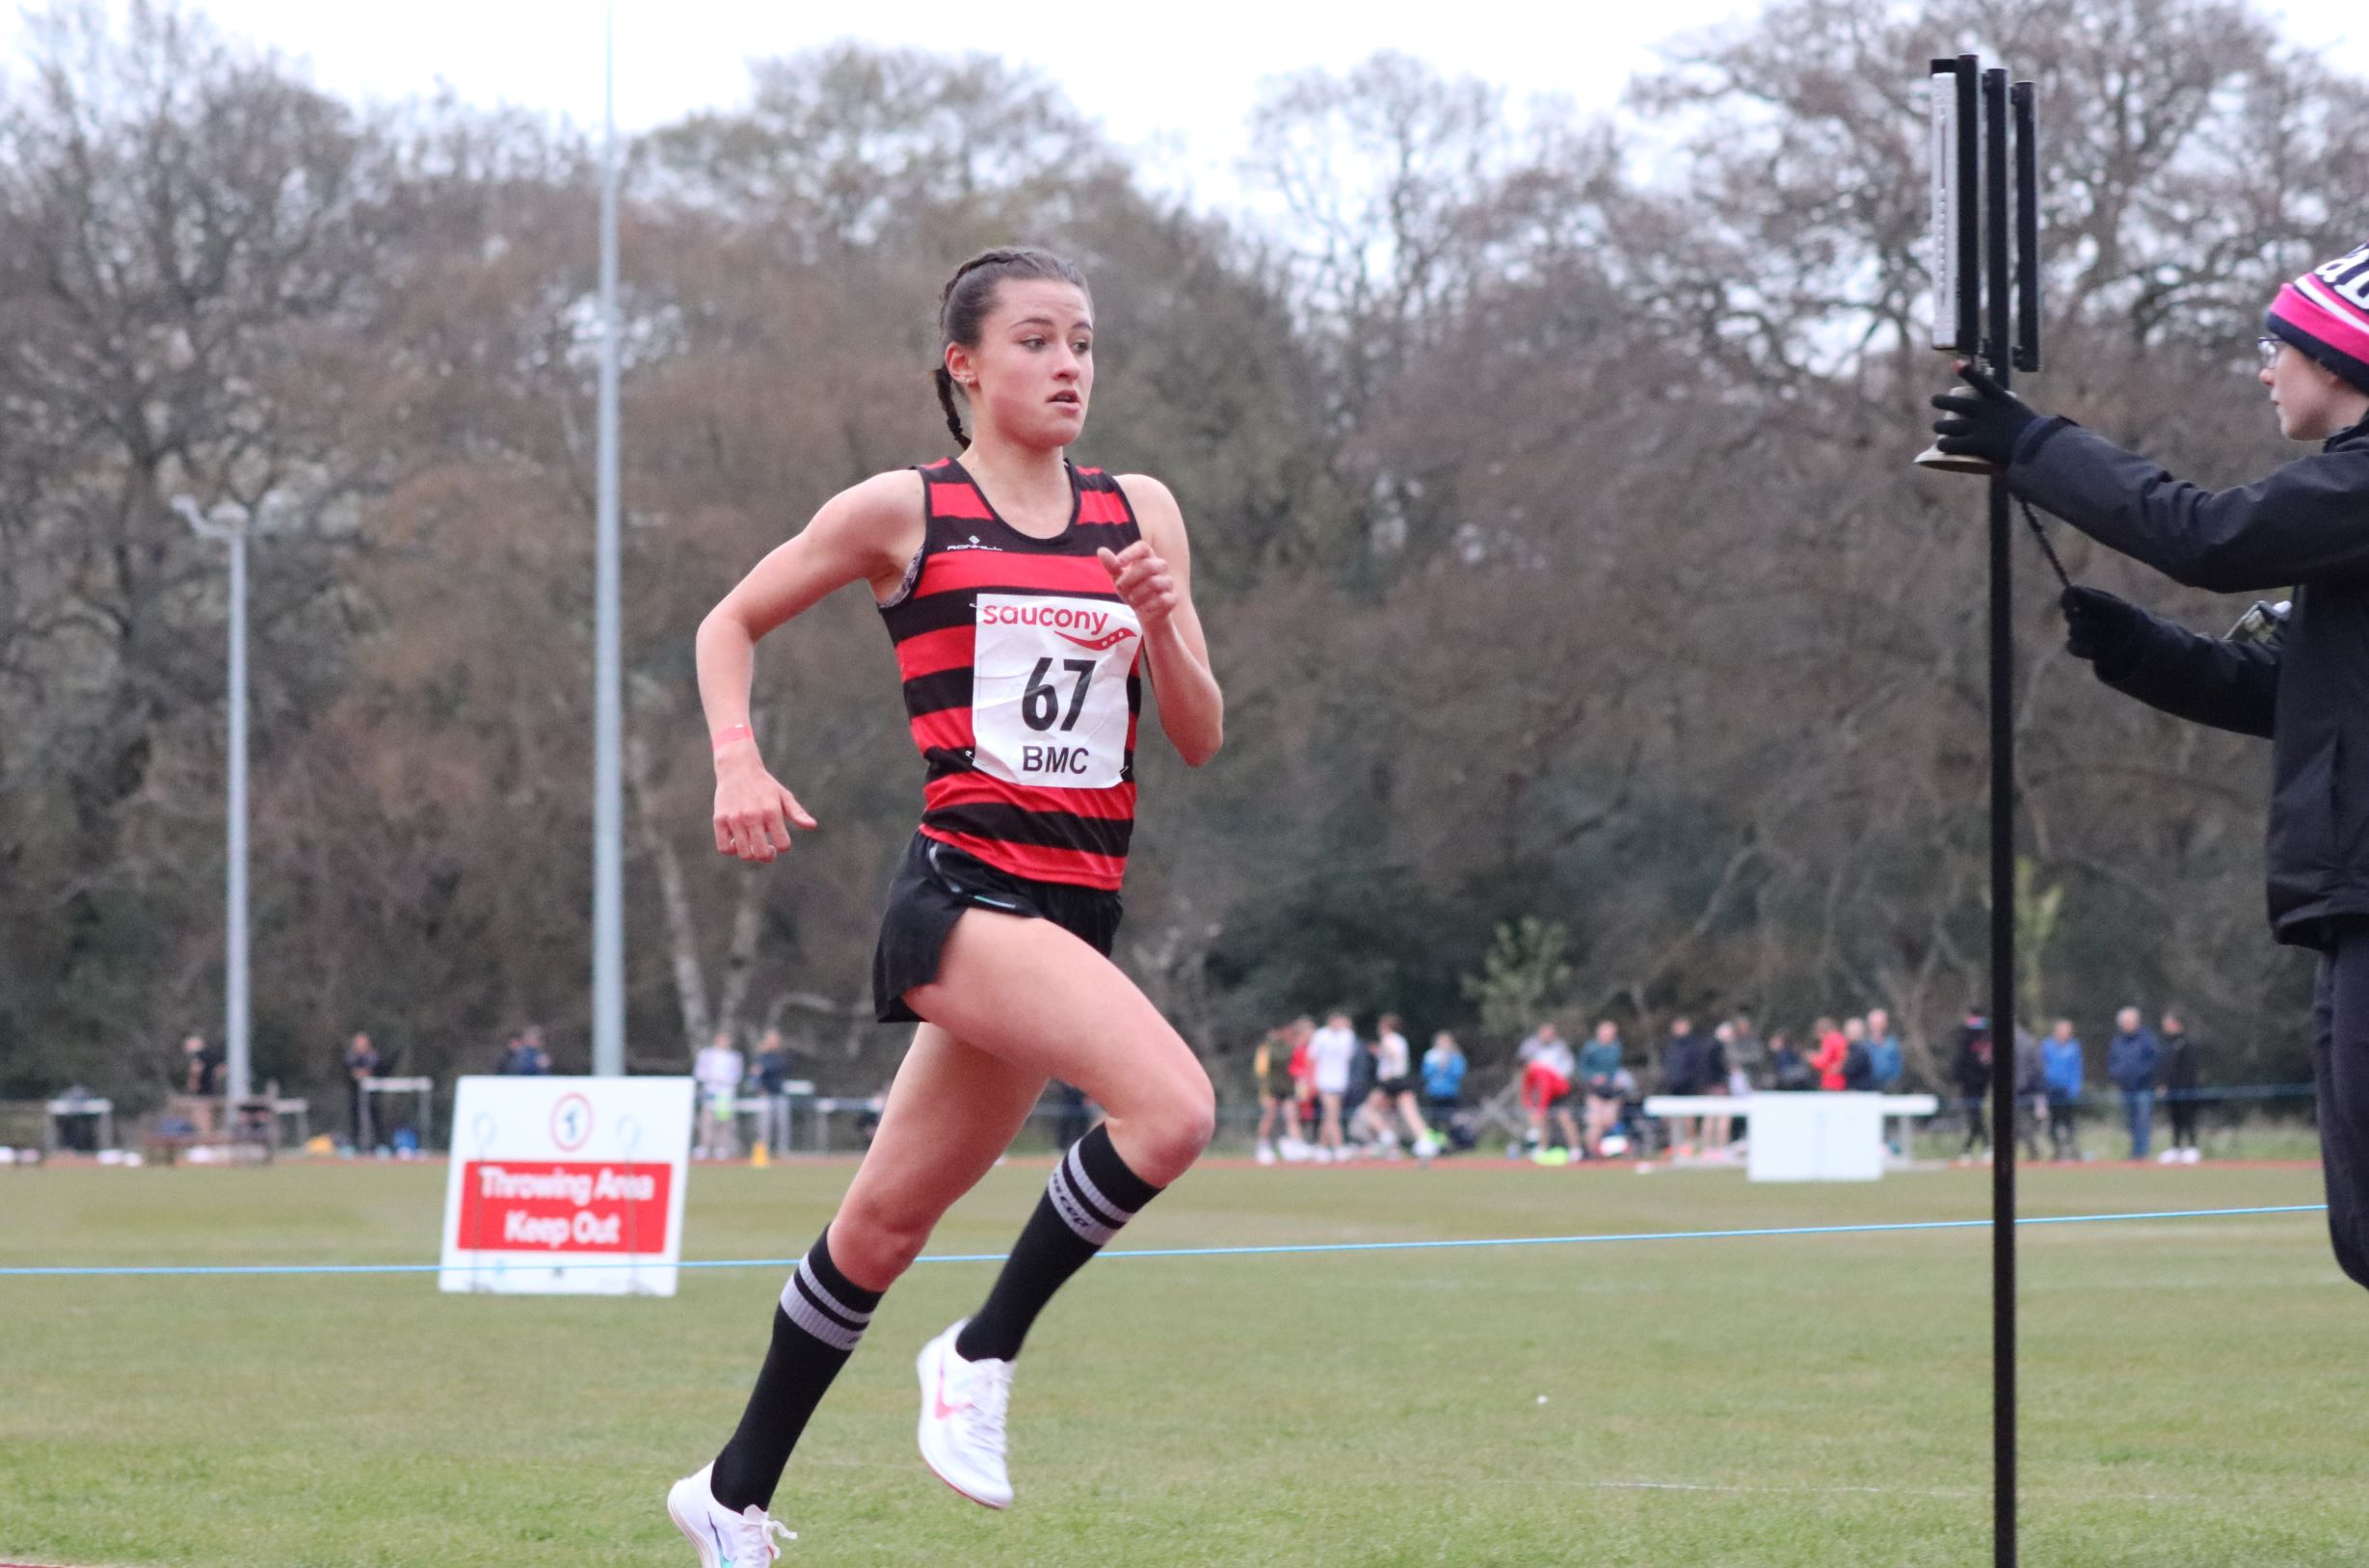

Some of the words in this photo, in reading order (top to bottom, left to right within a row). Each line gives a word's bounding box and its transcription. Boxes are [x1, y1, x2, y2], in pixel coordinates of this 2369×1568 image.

[982, 604, 1108, 636] saucony
[1022, 656, 1097, 731] 67
[1022, 745, 1089, 775] BMC
[478, 1165, 593, 1207] Throwing
[594, 1167, 655, 1200] Area
[504, 1209, 571, 1249] Keep
[572, 1210, 621, 1243] Out
